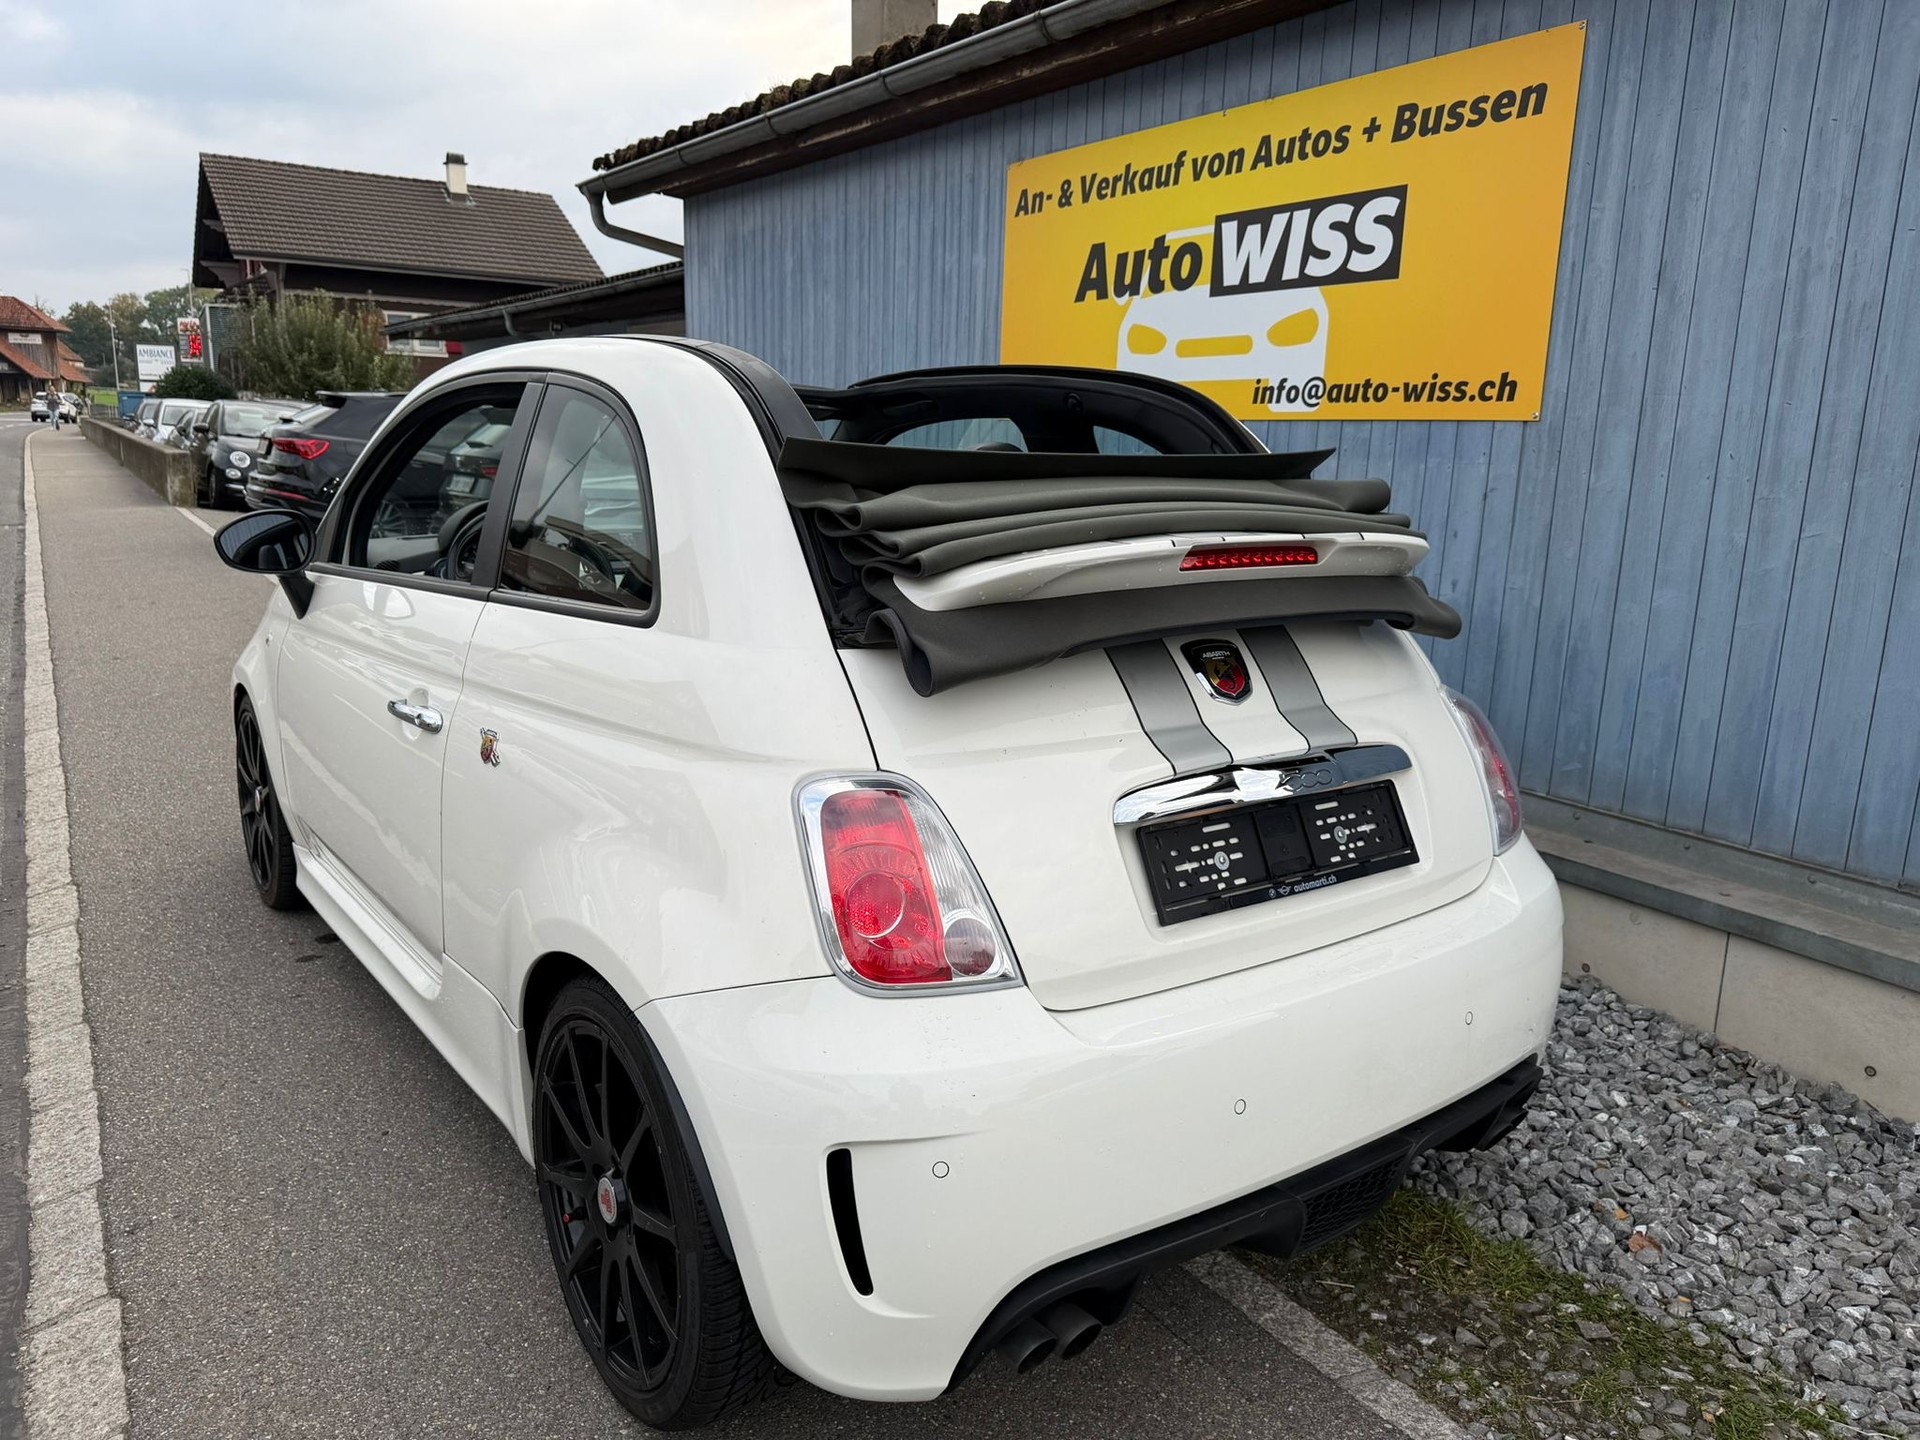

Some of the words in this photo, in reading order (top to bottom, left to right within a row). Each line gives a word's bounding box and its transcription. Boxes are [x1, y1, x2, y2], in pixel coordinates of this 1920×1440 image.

[1014, 188, 1053, 218] An-
[1057, 179, 1074, 209] &
[1080, 150, 1188, 204] Verkauf
[1191, 147, 1246, 182] von
[1249, 124, 1352, 171] Autos
[1362, 116, 1382, 143] +
[1390, 82, 1549, 144] Bussen
[1073, 234, 1203, 304] Auto
[1220, 196, 1402, 288] WISS
[138, 348, 173, 359] AMBIANCE
[1251, 371, 1518, 408] info@auto-wiss.ch
[1202, 650, 1231, 658] ABARTH
[1293, 873, 1337, 893] automarti.ch
